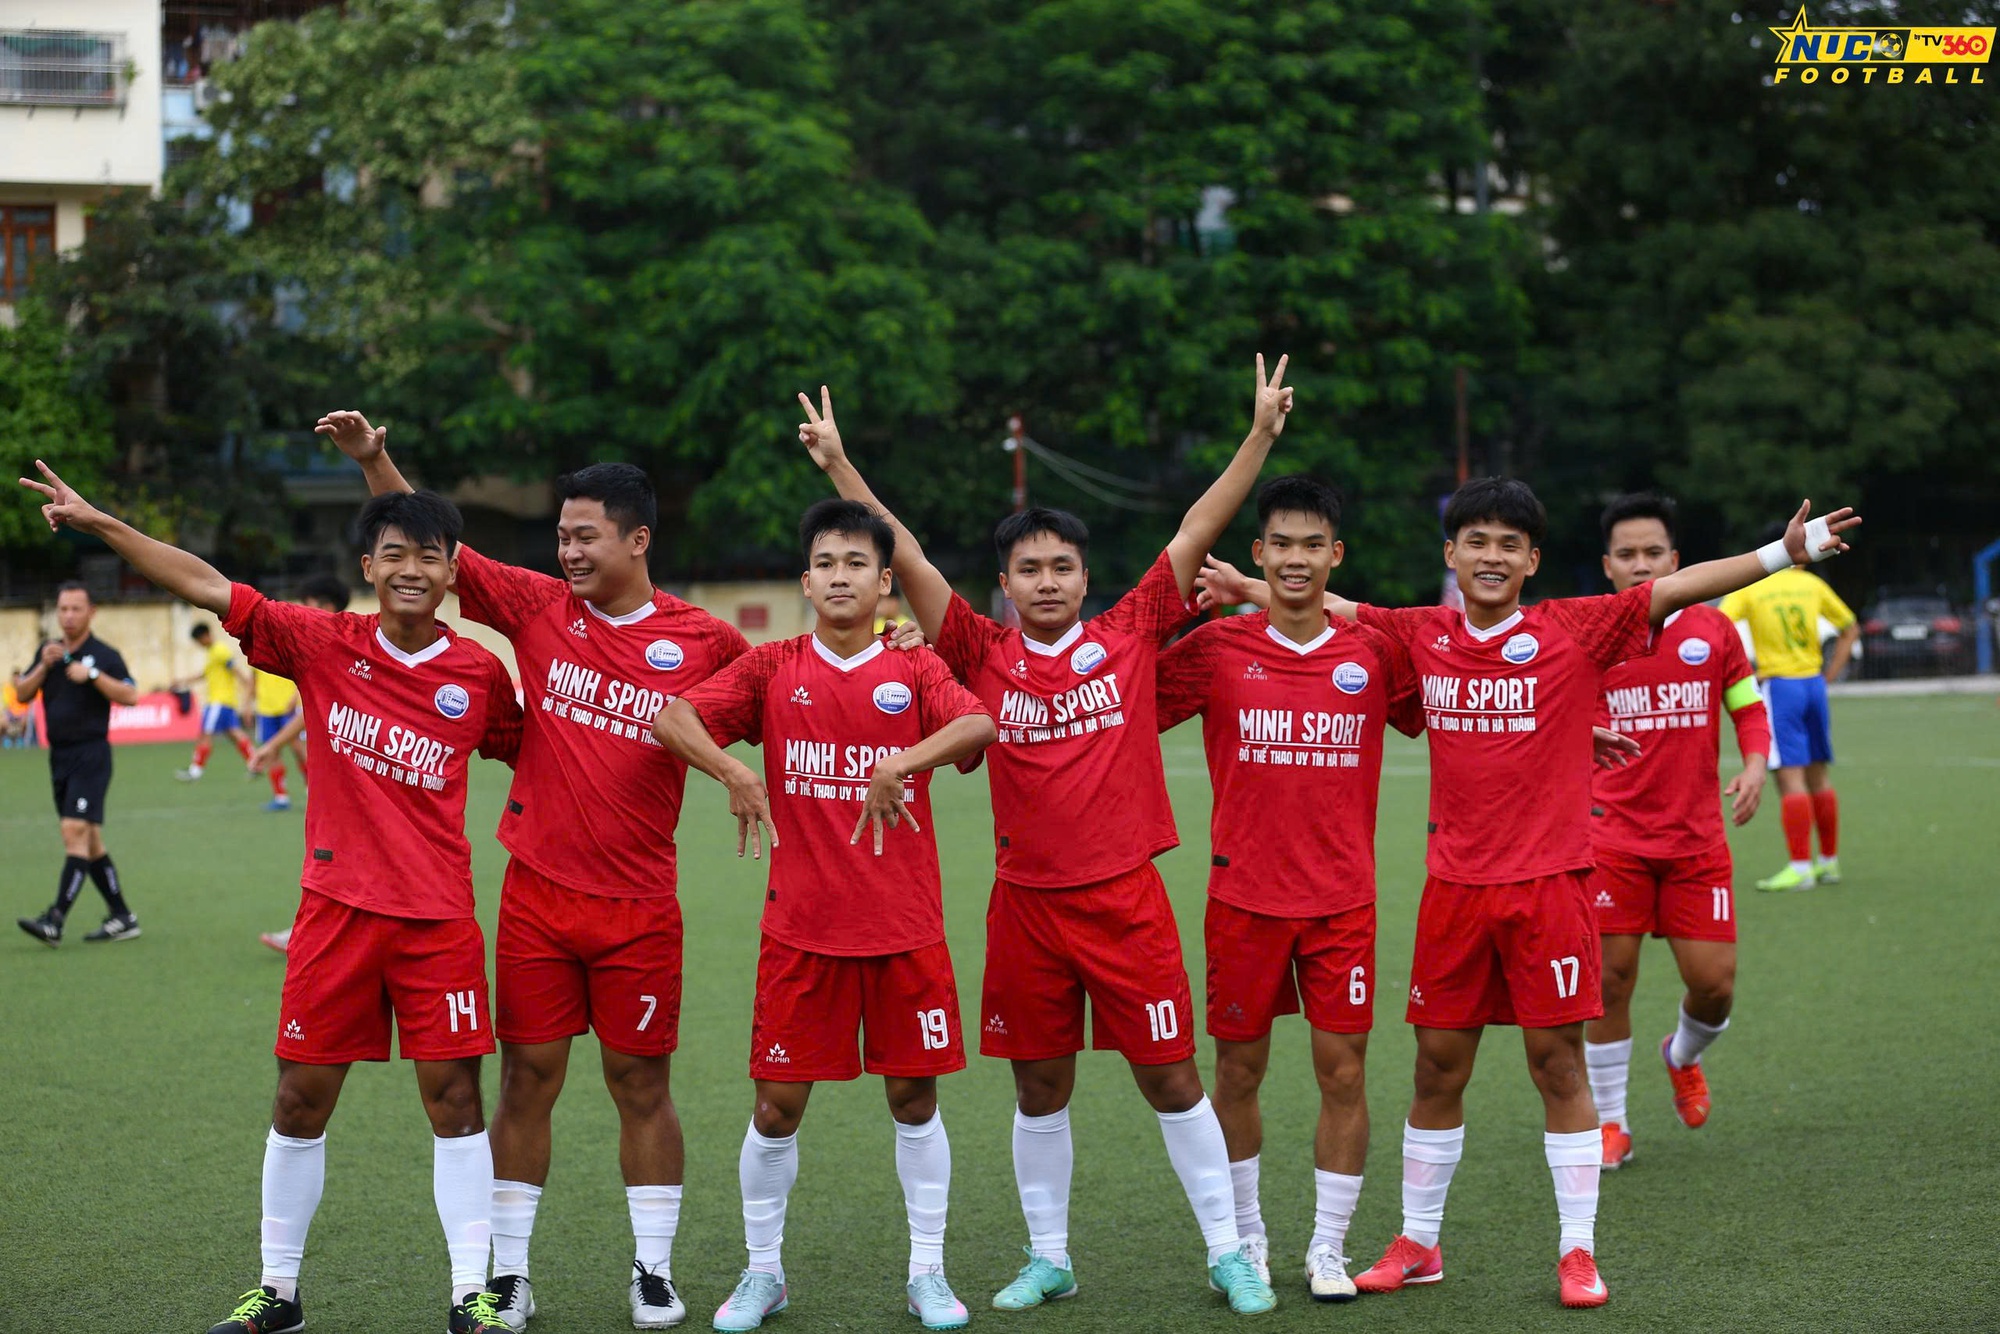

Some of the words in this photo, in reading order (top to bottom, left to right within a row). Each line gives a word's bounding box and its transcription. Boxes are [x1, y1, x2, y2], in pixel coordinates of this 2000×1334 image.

[548, 658, 602, 703] MINH
[1422, 674, 1460, 709] MINH
[1466, 677, 1538, 710] SPORT
[1606, 686, 1651, 715] MINH
[1657, 681, 1711, 710] SPORT
[1000, 690, 1048, 725] MINH
[1052, 673, 1121, 723] SPORT
[328, 701, 382, 748] MINH
[384, 725, 455, 776] SPORT
[571, 707, 591, 726] THAO
[594, 715, 610, 731] UY
[610, 716, 624, 736] TÍN
[625, 723, 639, 740] HÀ
[1028, 728, 1051, 743] THAO
[1085, 715, 1098, 733] HÀ
[1239, 708, 1293, 742] MINH
[1301, 711, 1366, 745] SPORT
[1462, 717, 1474, 732] UY
[1477, 715, 1490, 733] TÍN
[1492, 715, 1504, 733] HÀ
[1507, 714, 1536, 732] THÀNH
[353, 752, 374, 772] THAO
[376, 760, 389, 776] UY
[406, 769, 418, 786] HÀ
[785, 738, 836, 776] MINH
[1270, 749, 1293, 765] THAO
[1295, 751, 1309, 766] UY
[1312, 750, 1325, 767] TÍN
[814, 783, 836, 800] THAO
[839, 786, 853, 801] UY
[1712, 887, 1729, 921] 11
[1349, 965, 1366, 1005] 6
[1550, 955, 1579, 998] 17
[445, 990, 478, 1033] 14
[636, 995, 657, 1031] 7
[917, 1008, 949, 1050] 19
[1145, 999, 1178, 1042] 10
